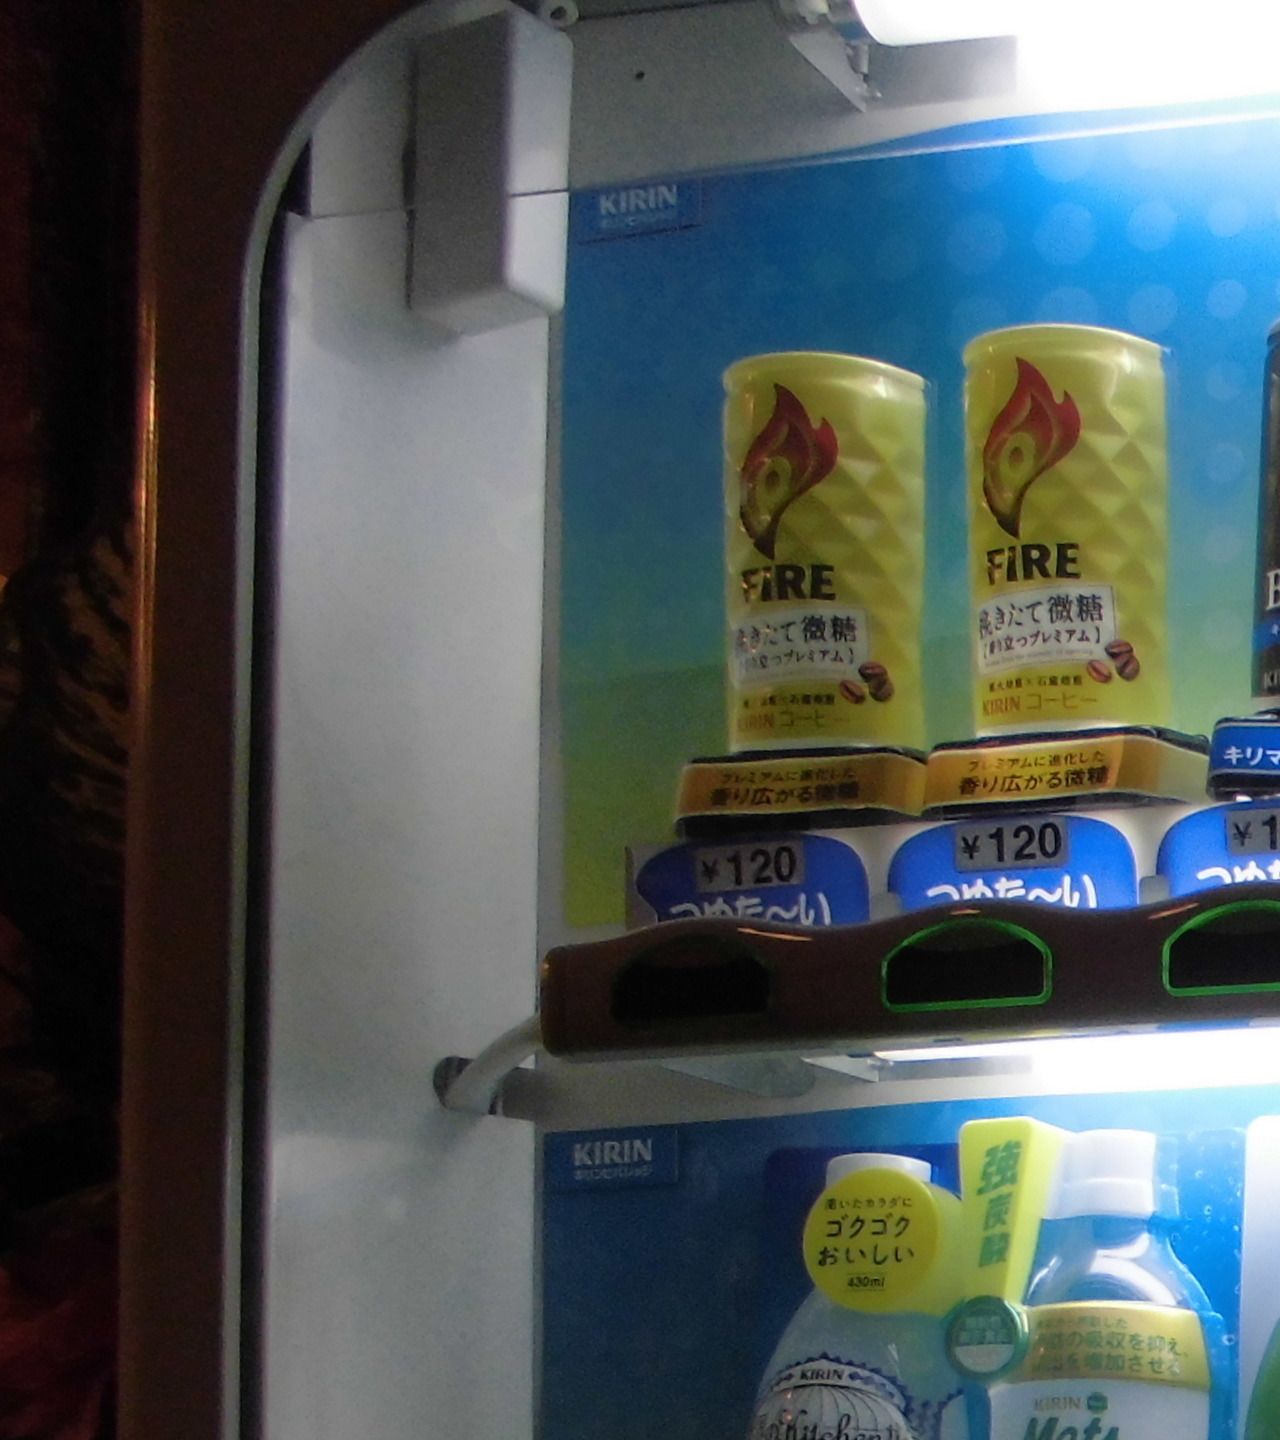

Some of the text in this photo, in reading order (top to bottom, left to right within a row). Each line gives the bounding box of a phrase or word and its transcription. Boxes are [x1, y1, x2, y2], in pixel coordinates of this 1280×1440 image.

[987, 543, 1082, 585] FIRE
[741, 564, 836, 601] FIRE
[961, 821, 1062, 863] ¥120
[574, 1138, 652, 1167] KIRIN
[825, 1216, 912, 1240] ゴクゴク
[818, 1242, 915, 1268] おいしい
[800, 1366, 846, 1383] KIRIN
